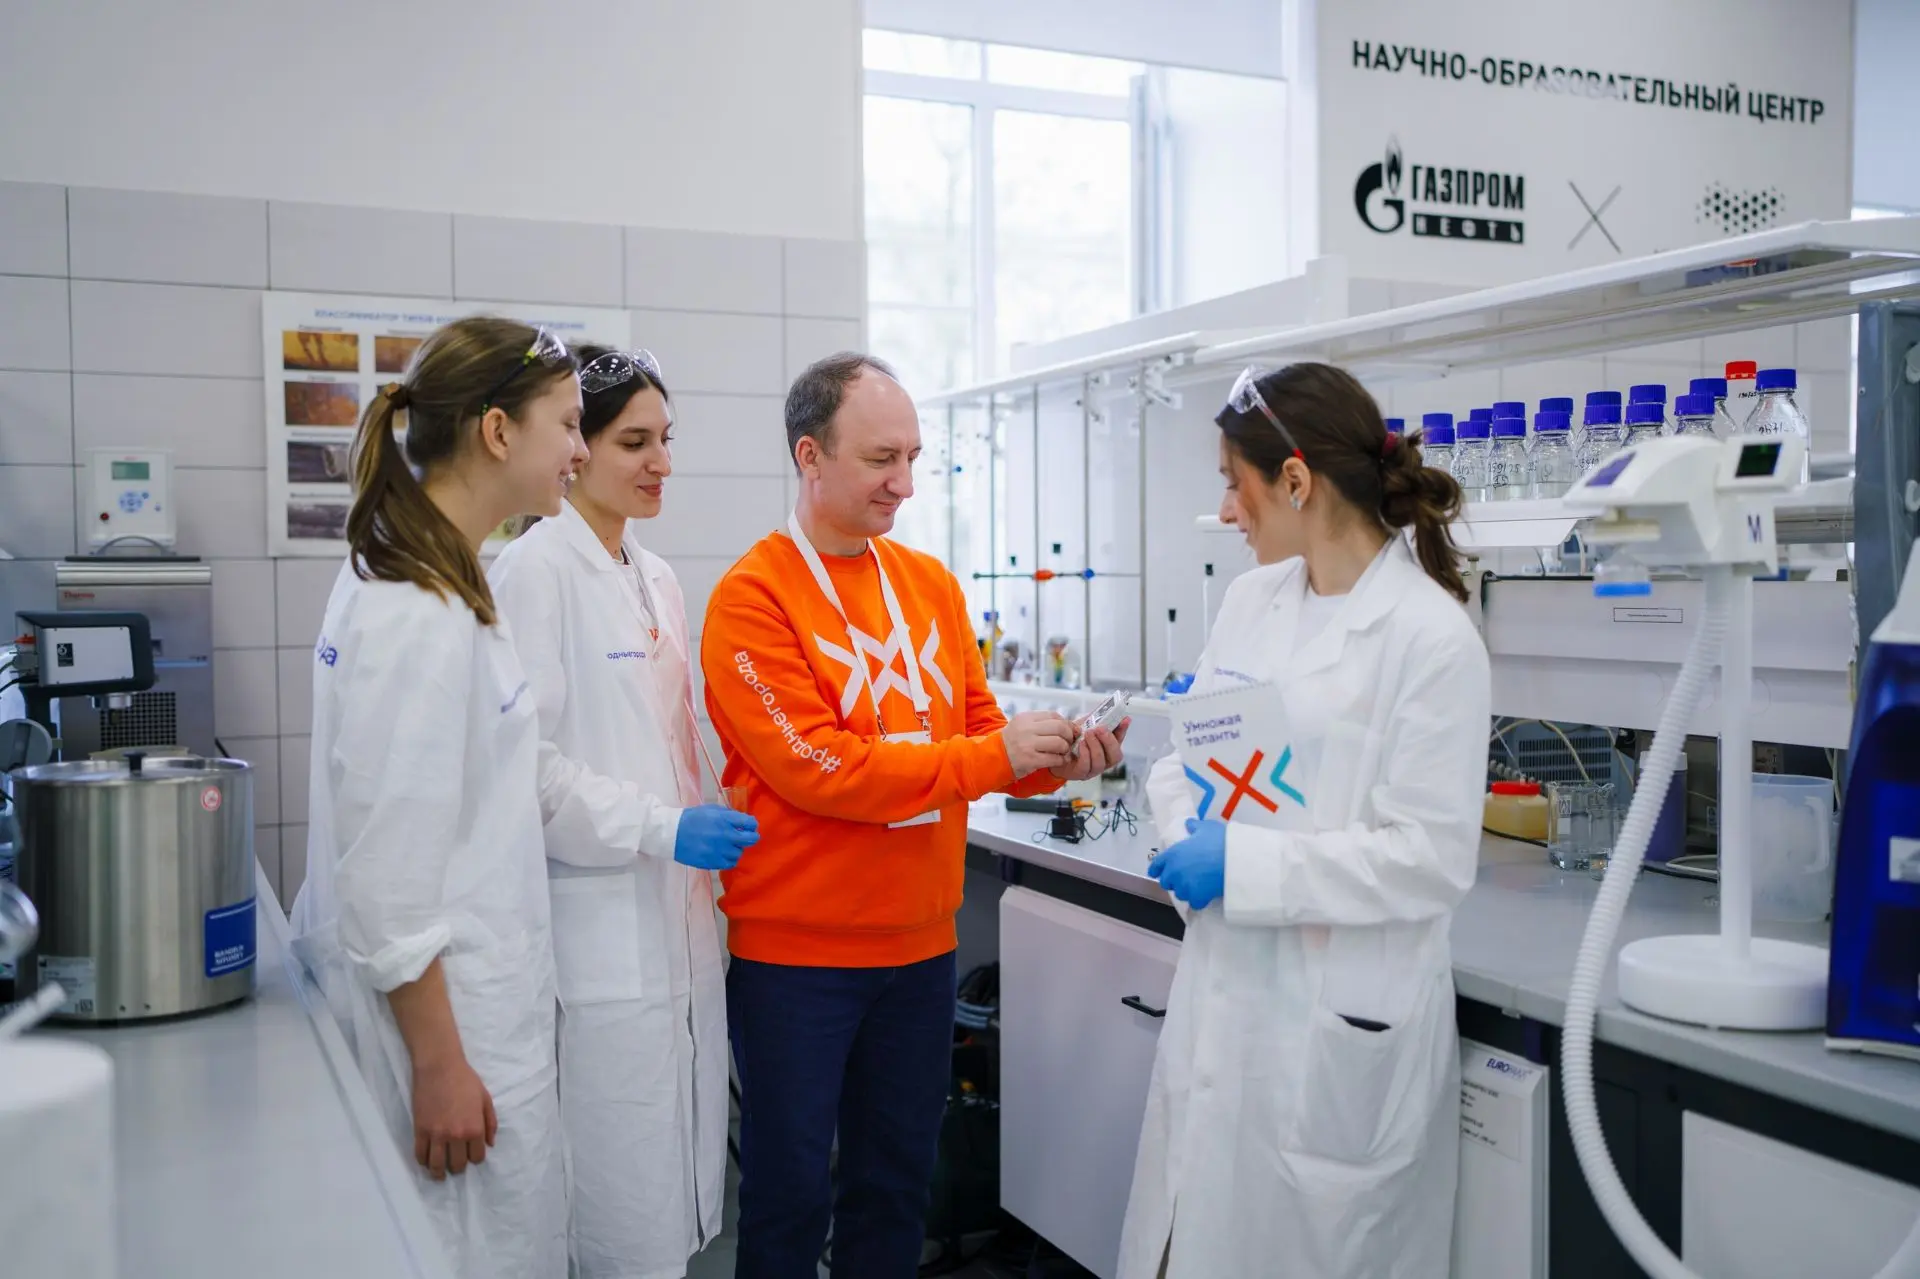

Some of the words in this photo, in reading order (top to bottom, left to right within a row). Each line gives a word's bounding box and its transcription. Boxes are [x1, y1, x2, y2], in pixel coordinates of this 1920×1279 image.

[1352, 40, 1741, 115] НАУЧНО-ОБРАЗОВАТЕЛЬНЫЙ
[1748, 91, 1825, 124] ЦЕНТР
[1412, 165, 1524, 210] ГАЗПРОМ
[1414, 215, 1522, 243] НЕФТЬ
[1183, 714, 1242, 734] Умножая
[1187, 729, 1240, 747] таланты
